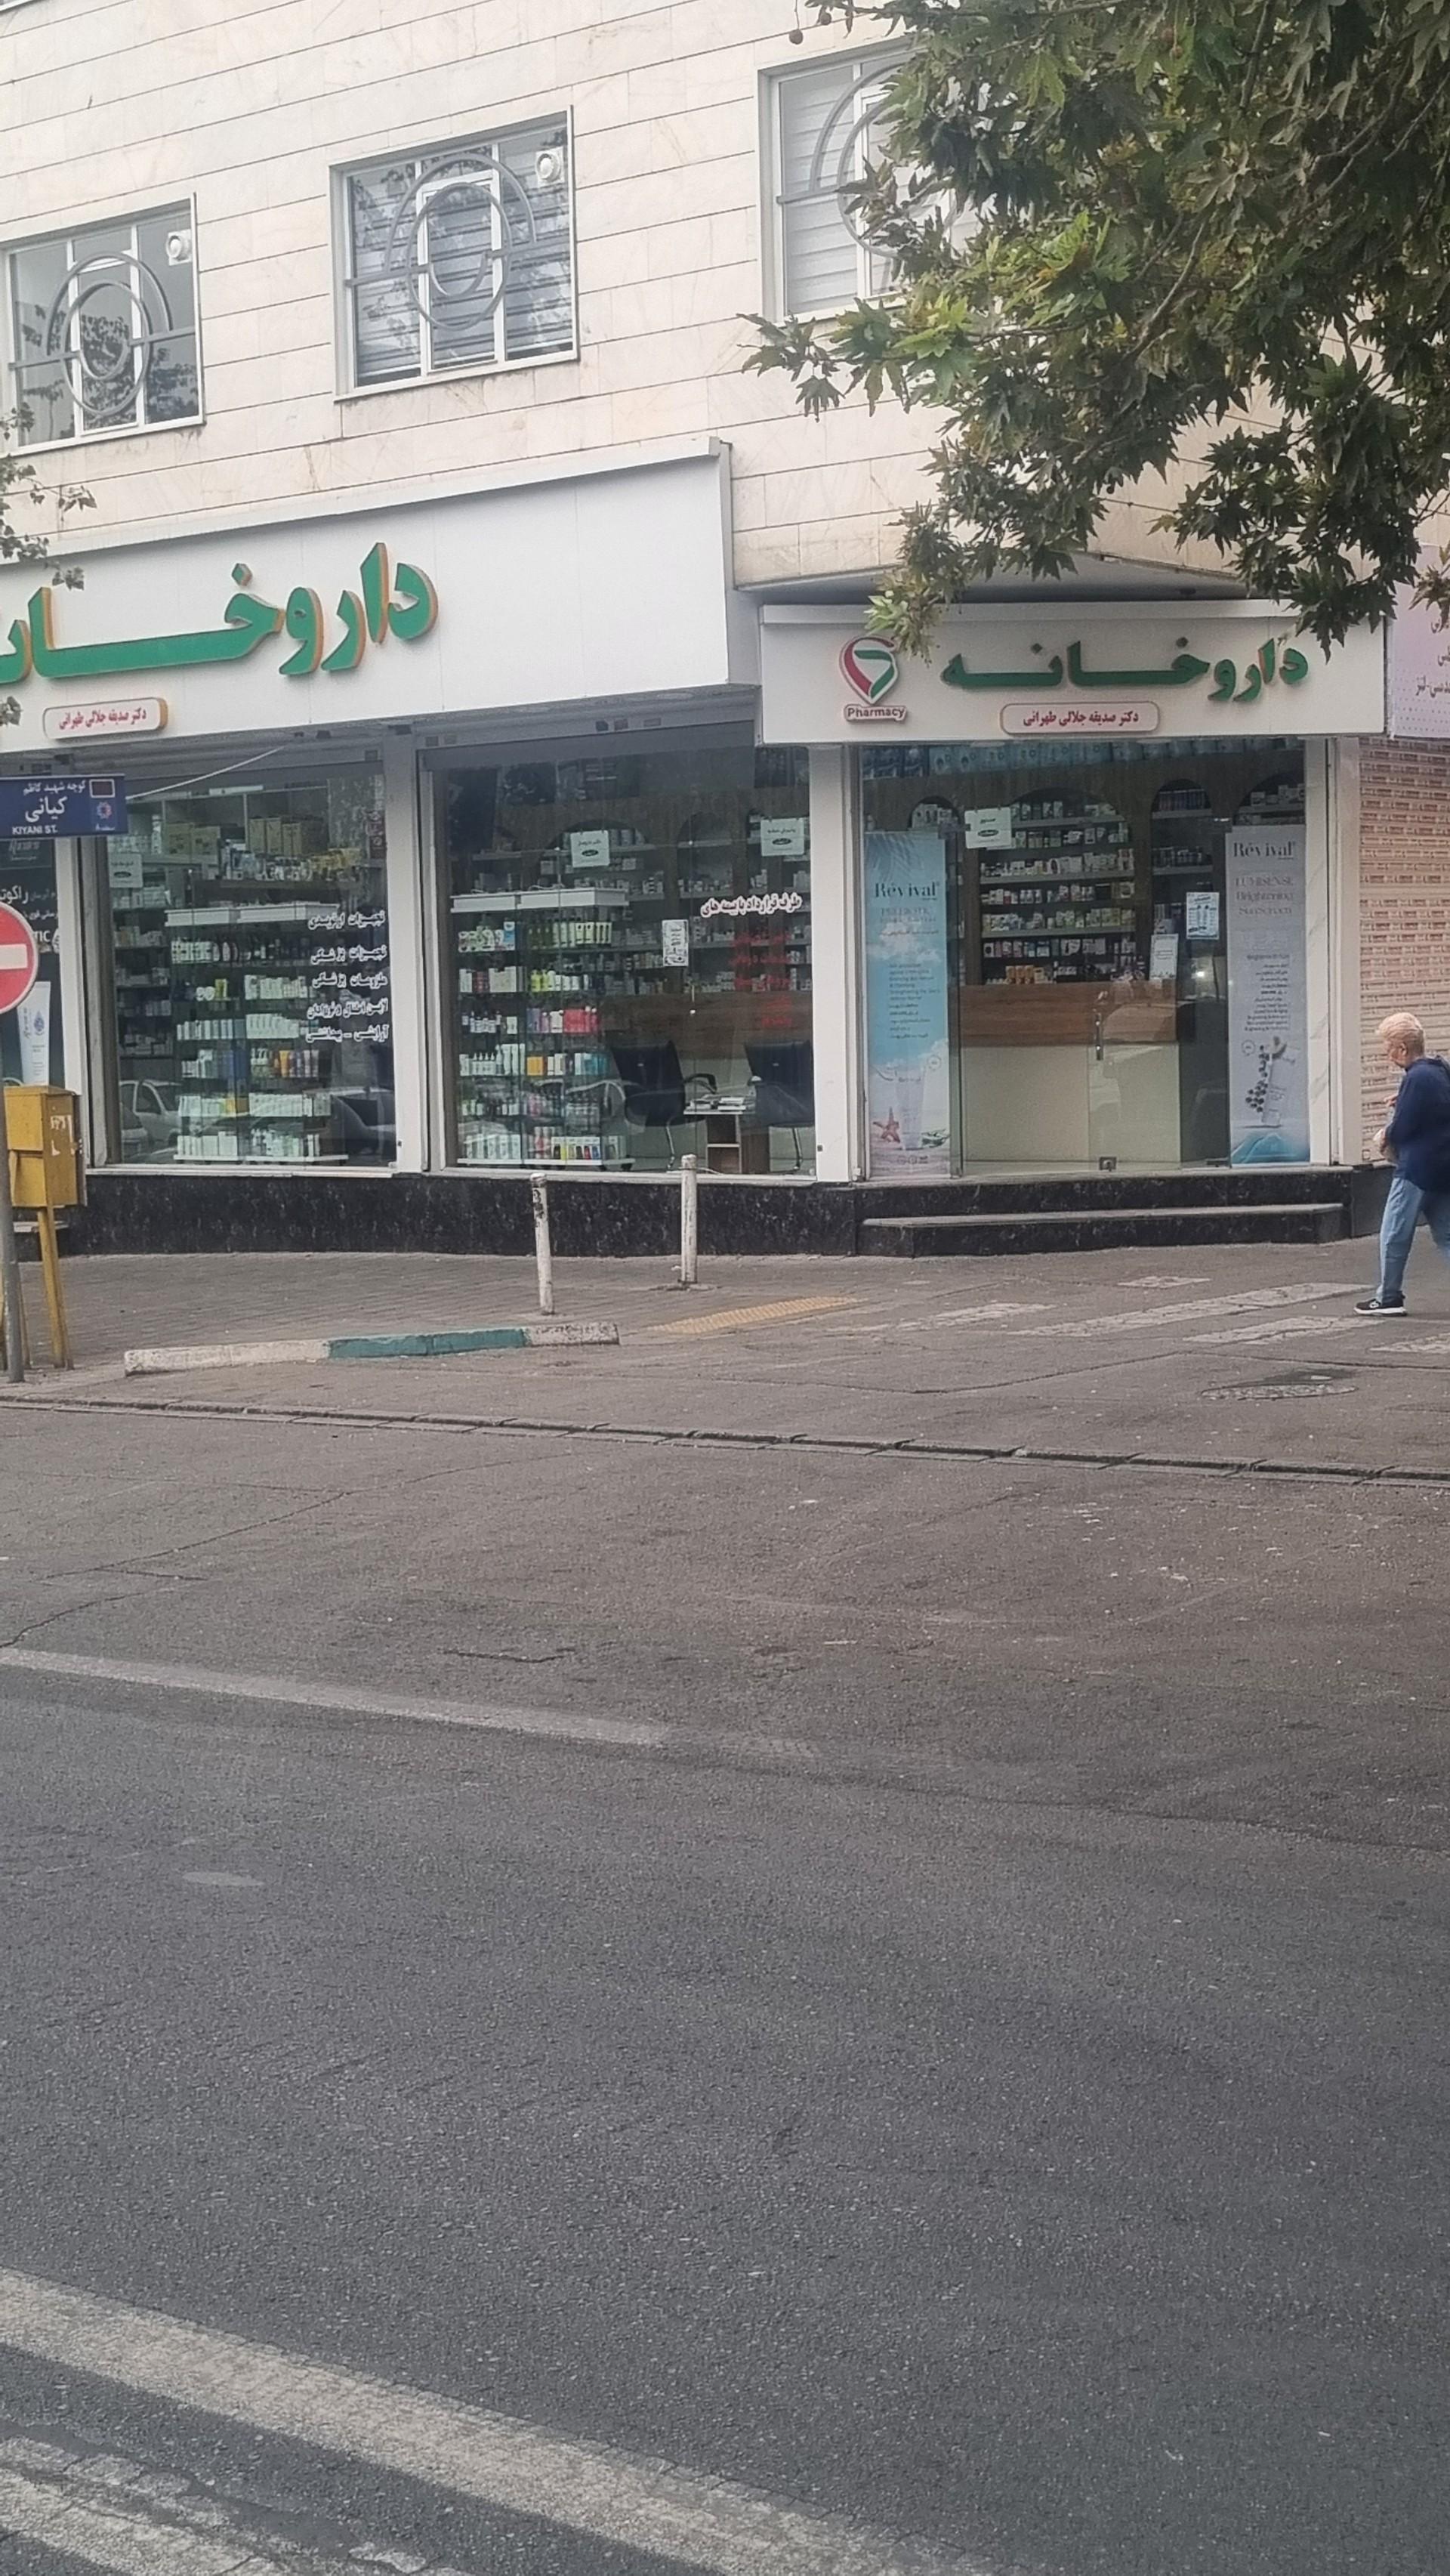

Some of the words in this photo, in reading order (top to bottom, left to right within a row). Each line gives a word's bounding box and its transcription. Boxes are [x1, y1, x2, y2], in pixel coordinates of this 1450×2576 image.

[940, 636, 1309, 703] داروخانه
[58, 712, 84, 730] طهرانی
[85, 709, 106, 727] جلالی
[108, 709, 129, 725] صدیقه
[131, 707, 147, 725] دکتر
[847, 707, 905, 718] Pharmacy
[1023, 710, 1057, 727] طهرانی
[1059, 710, 1087, 726] جلالی
[1088, 710, 1116, 726] صدیقه
[1118, 710, 1139, 726] دکتر
[44, 782, 66, 794] شهید
[66, 780, 86, 793] کوچه
[25, 795, 68, 822] کیانی
[12, 825, 43, 835] KIYANI
[45, 824, 58, 834] ST.
[779, 892, 803, 913] طرف
[308, 912, 346, 930] ارتوپدی
[347, 910, 386, 928] تجهیزات
[310, 947, 346, 965] پزشکی
[349, 944, 387, 962] تجهیزات
[312, 971, 347, 989] پزشکی
[350, 971, 388, 990] ملزومات
[354, 1024, 390, 1042] آرایشی
